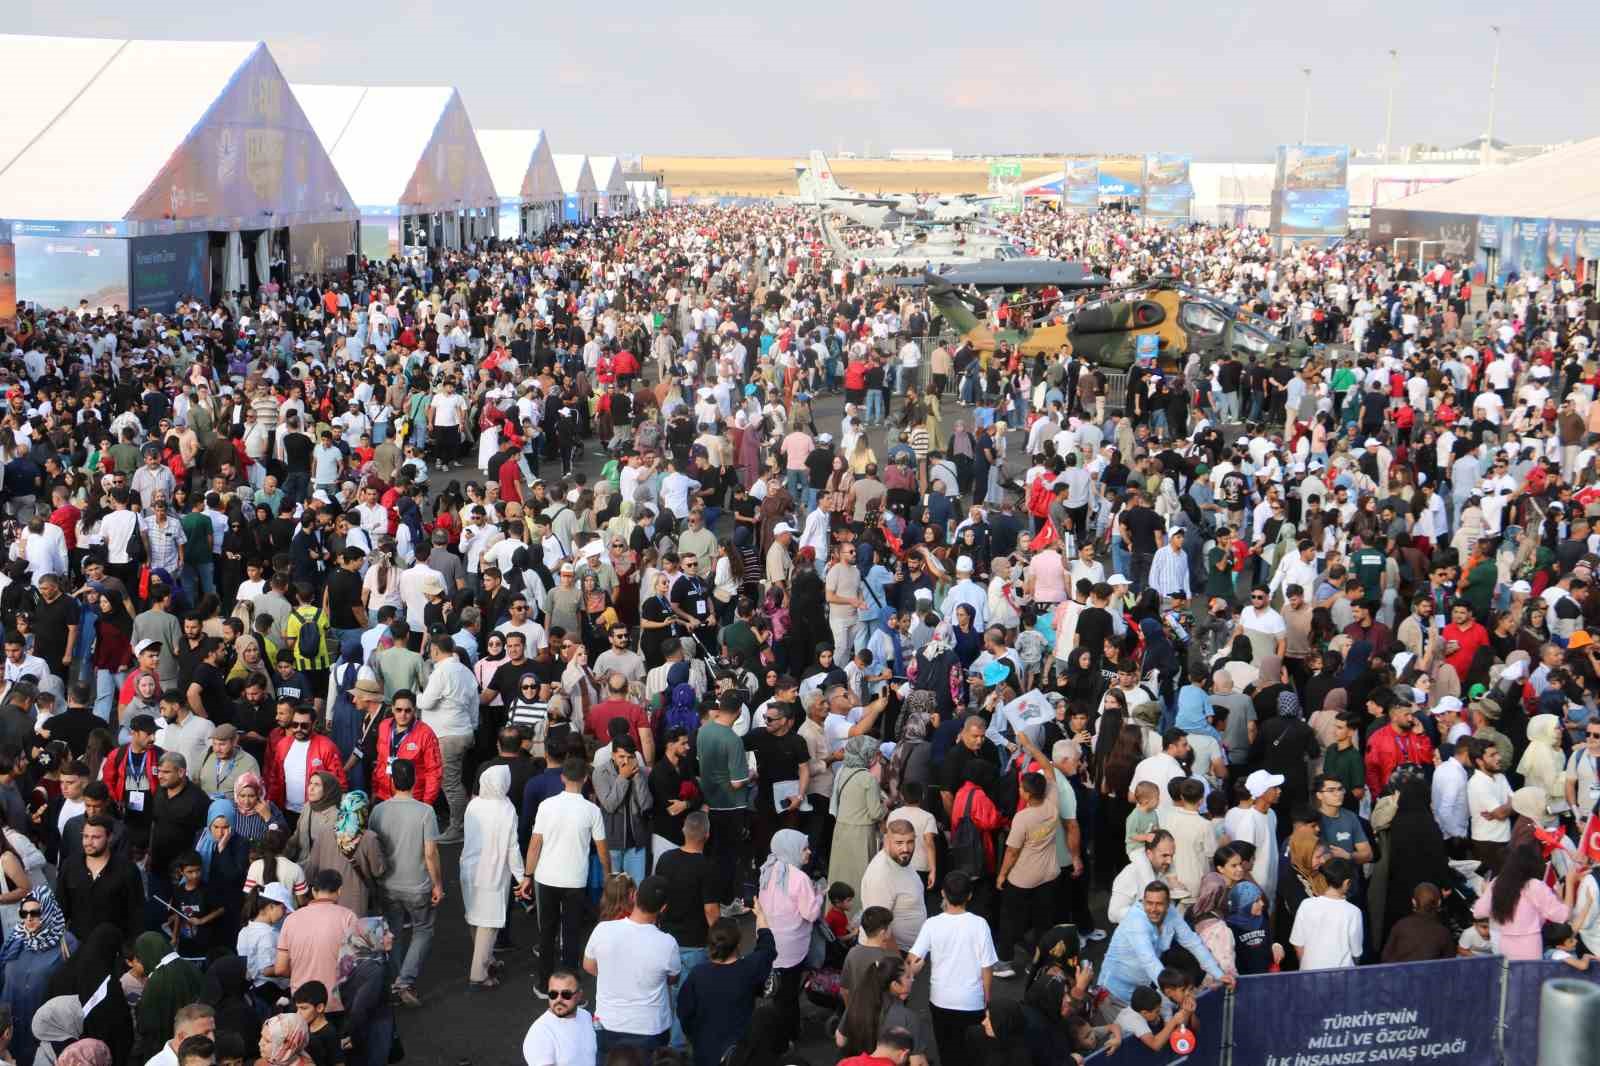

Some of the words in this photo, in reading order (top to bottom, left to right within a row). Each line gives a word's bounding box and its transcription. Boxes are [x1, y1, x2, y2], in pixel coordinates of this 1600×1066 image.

[1323, 1008, 1418, 1030] TÜRKİYE'NİN
[1308, 1031, 1349, 1049] MİLLİ
[1353, 1033, 1373, 1045] VE
[1376, 1026, 1430, 1043] ÖZGÜN
[1295, 1053, 1366, 1066] İNSANSIZ
[1368, 1046, 1417, 1061] SAVAŞ
[1421, 1038, 1466, 1059] UÇAĞI
